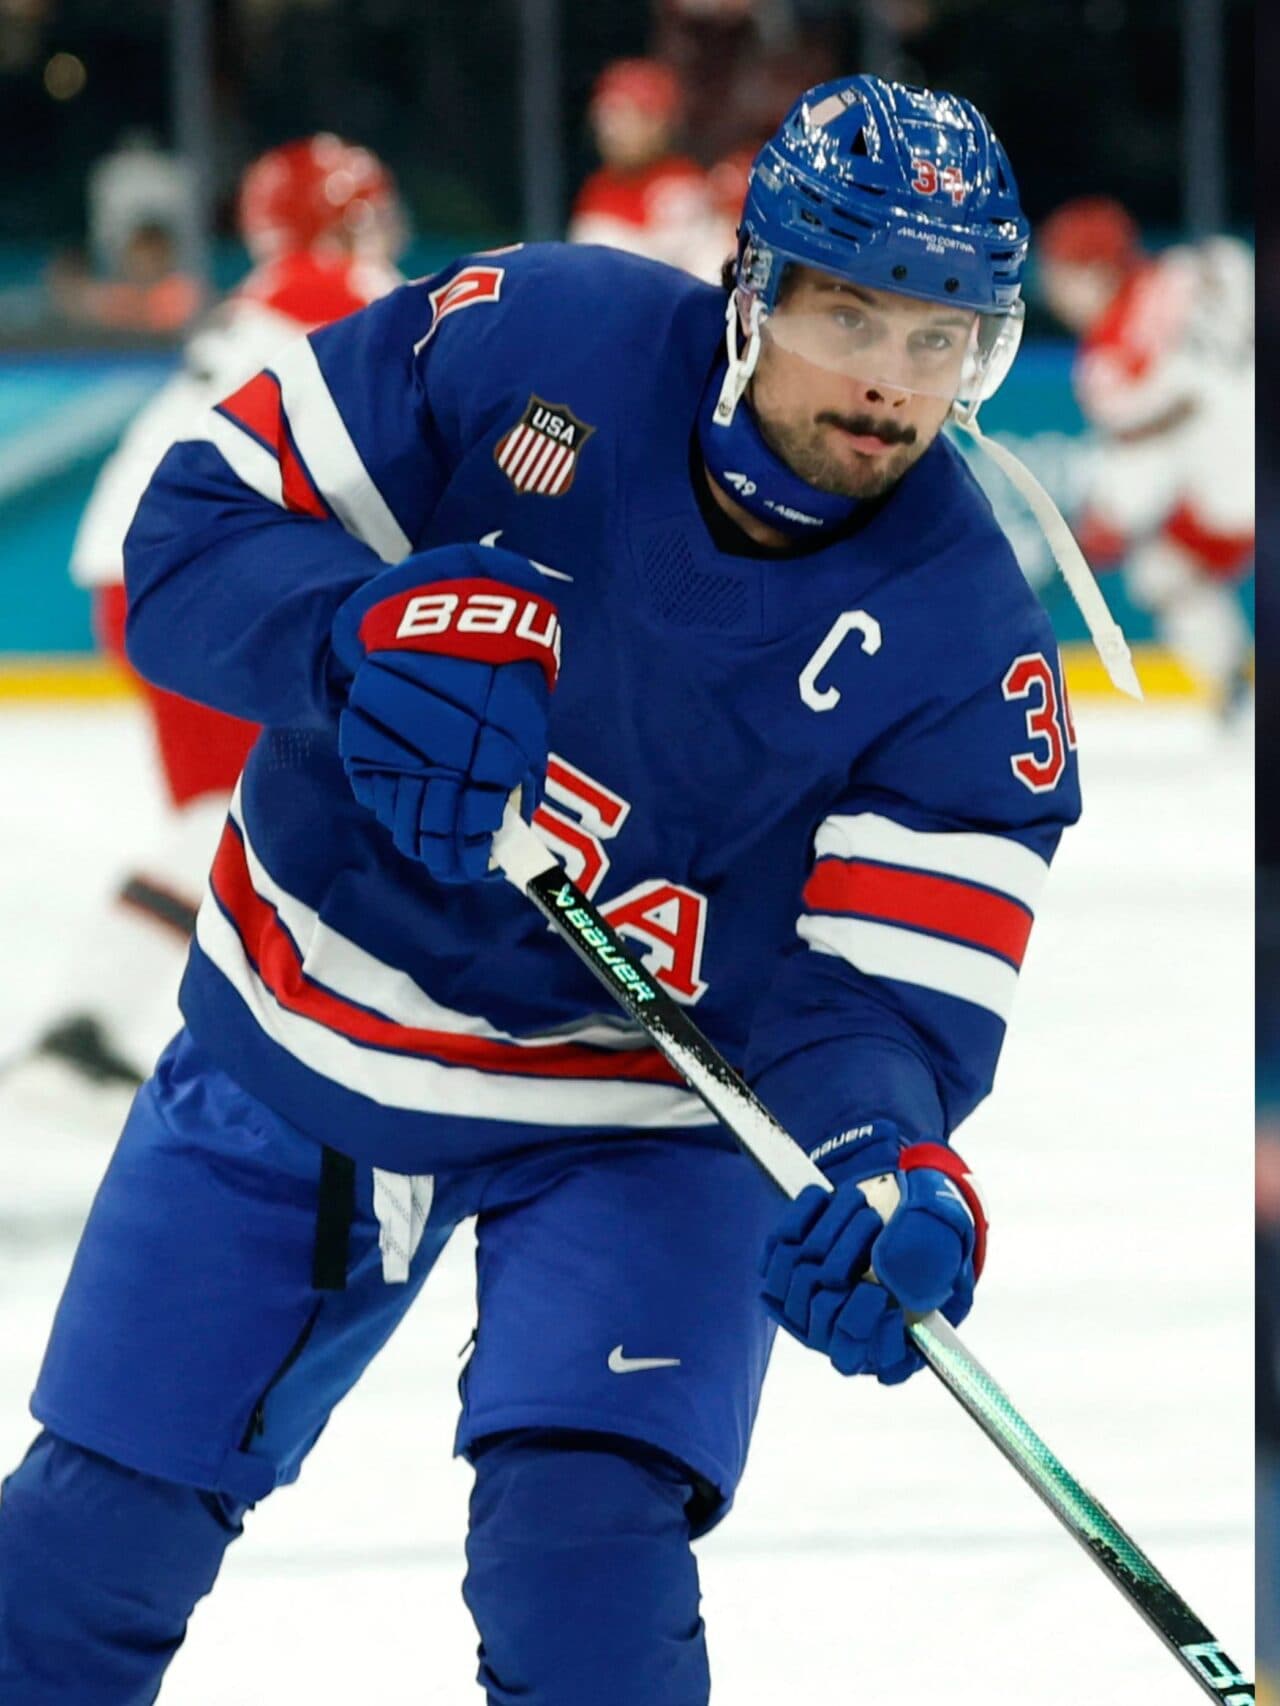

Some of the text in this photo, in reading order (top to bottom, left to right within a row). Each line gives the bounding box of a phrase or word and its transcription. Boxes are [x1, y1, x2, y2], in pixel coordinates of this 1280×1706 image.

[910, 160, 966, 207] 34
[531, 407, 577, 446] USA
[396, 593, 561, 680] BAU
[799, 609, 882, 713] C
[1002, 647, 1078, 794] 3
[565, 907, 656, 1003] BAUER
